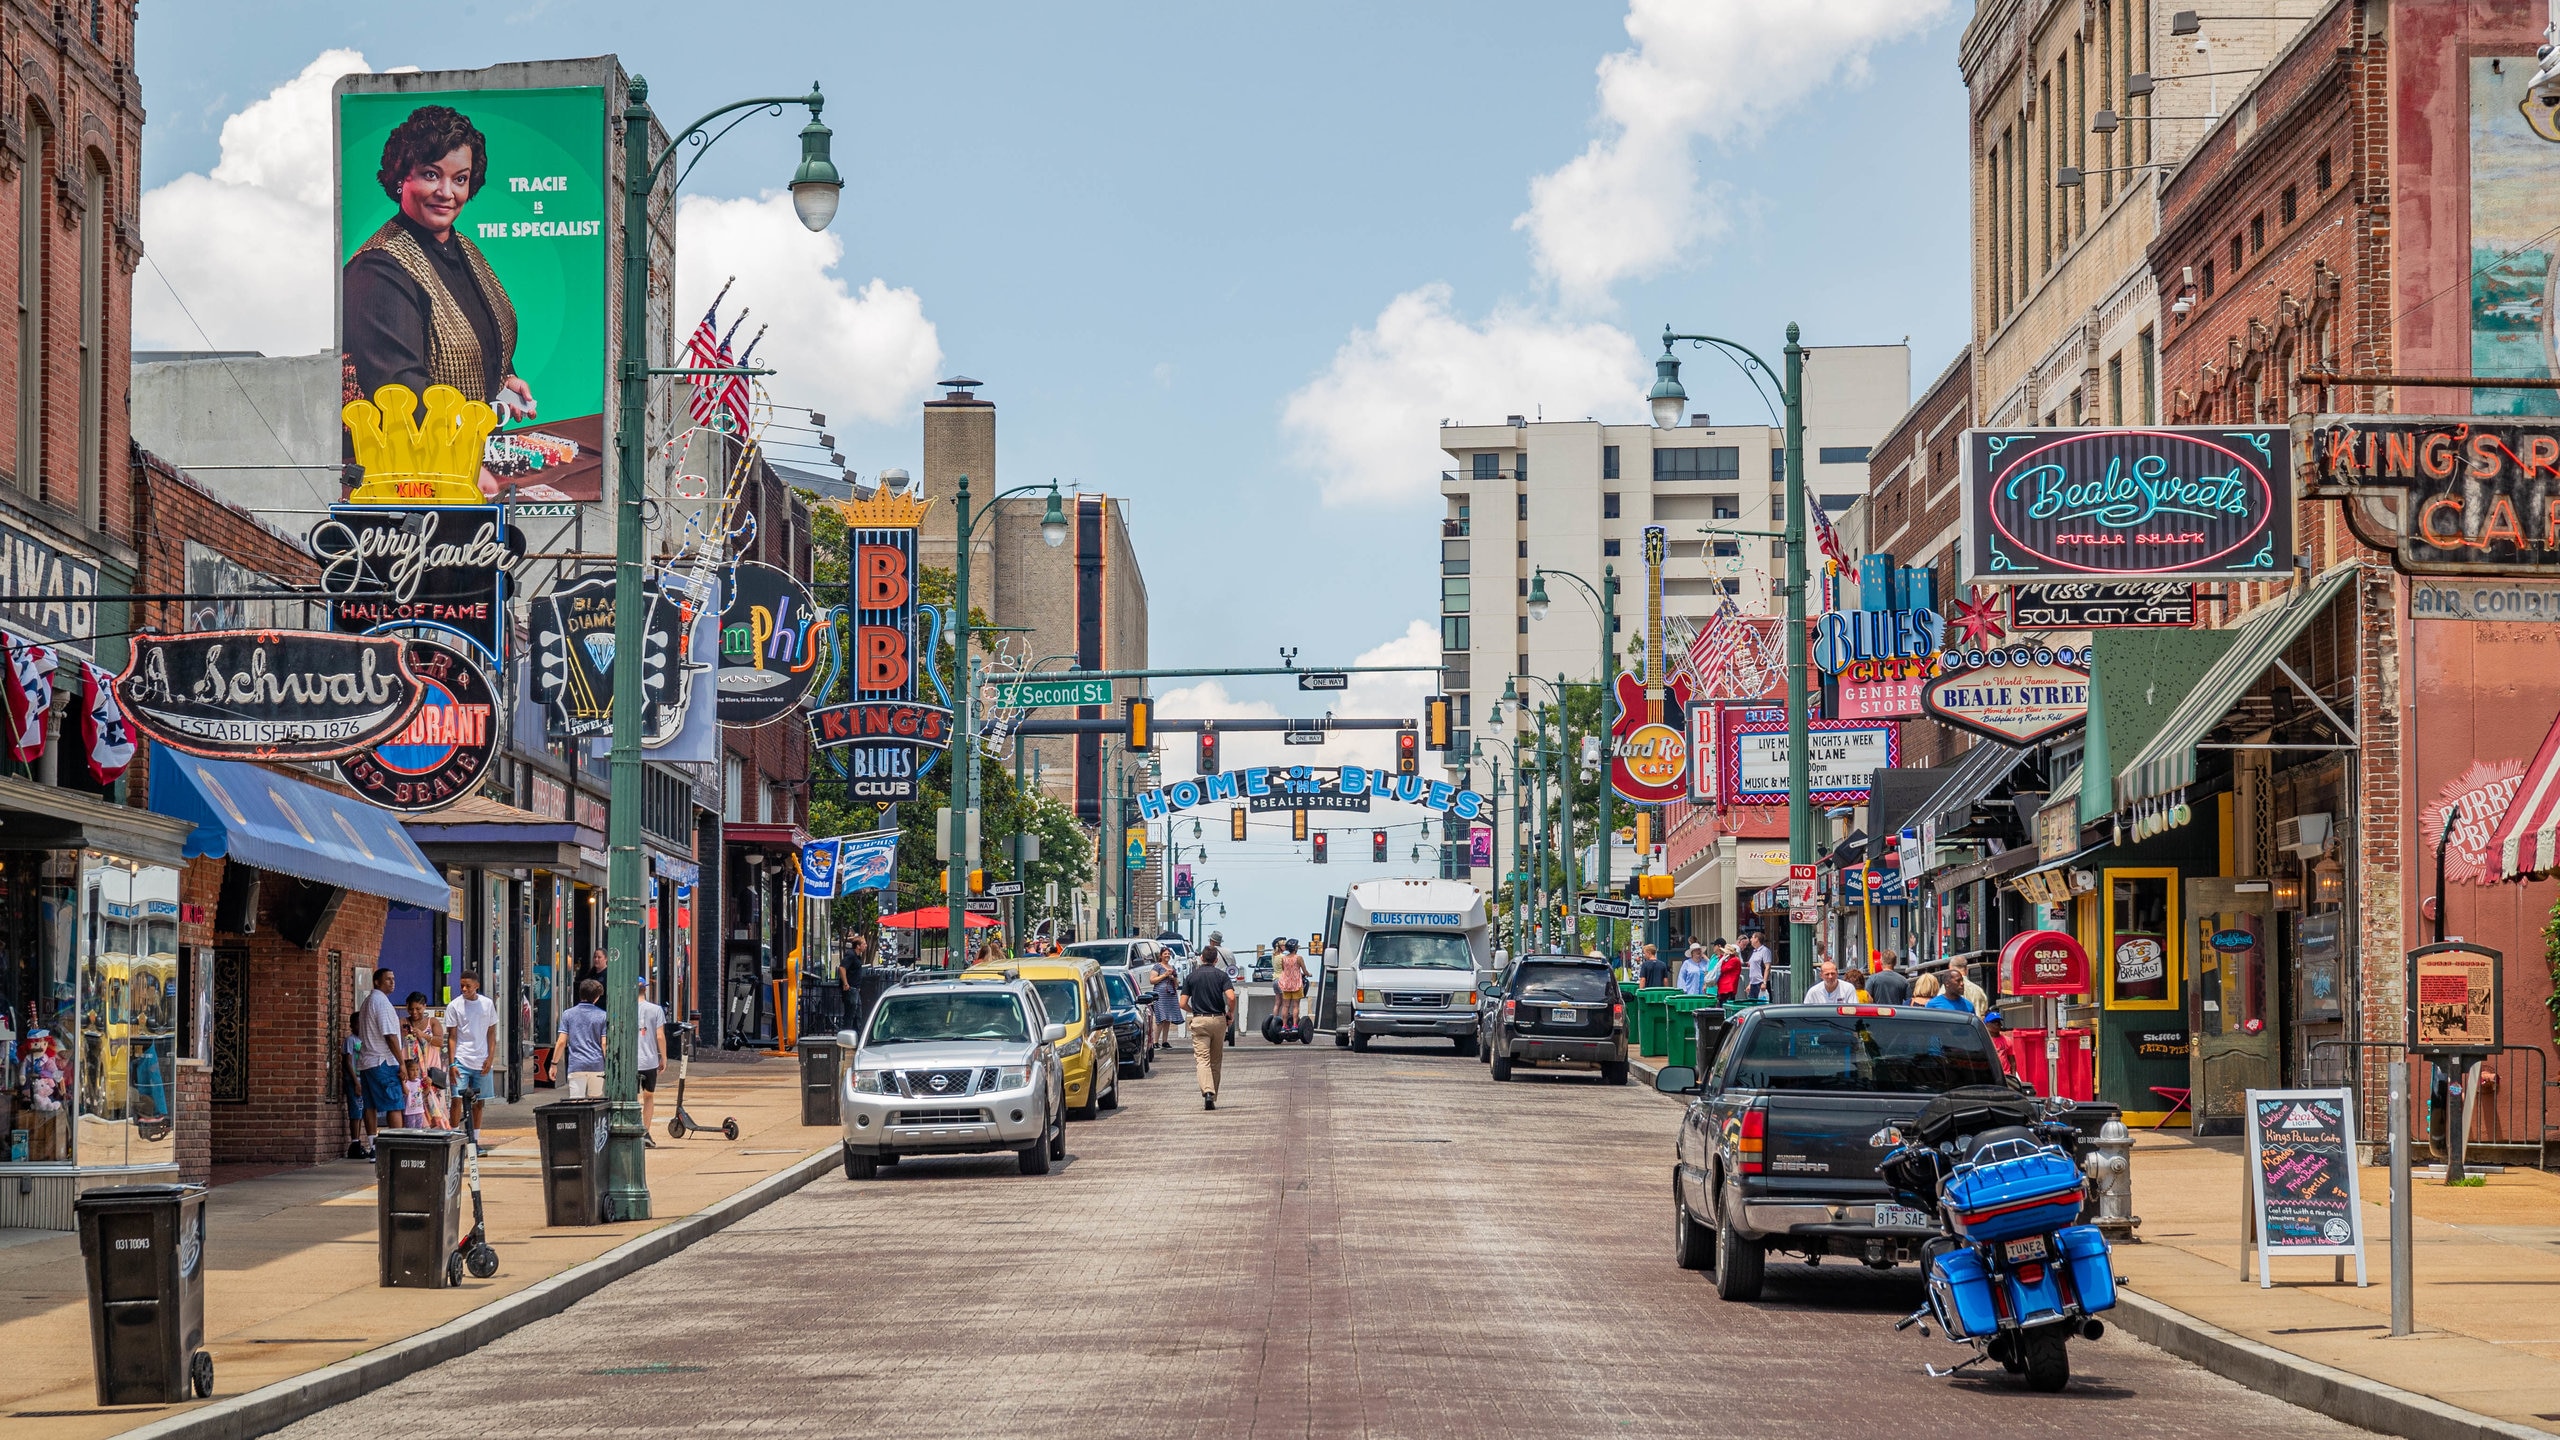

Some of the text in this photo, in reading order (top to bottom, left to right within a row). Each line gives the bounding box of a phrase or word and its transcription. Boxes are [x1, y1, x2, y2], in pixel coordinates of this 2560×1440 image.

[509, 176, 567, 192] TRACIE
[534, 201, 543, 212] IS
[477, 220, 600, 238] THE SPECIALIST
[2327, 423, 2502, 480] KING'S
[2006, 455, 2249, 528] Beale Sweets
[507, 505, 576, 516] AMAR
[2056, 532, 2205, 545] SUGAR SHACK
[311, 511, 518, 604] Jerry Lawler
[573, 597, 616, 611] BLA
[2418, 588, 2462, 613] AIR
[340, 603, 488, 619] HALL OF FAME
[2018, 606, 2191, 625] SOUL CITY CAFE
[567, 611, 616, 632] DIAMO
[718, 595, 831, 672] mphis
[1828, 608, 1934, 675] BLUES
[1945, 649, 2092, 666] WELCOME
[194, 644, 403, 704] Schwab
[1847, 657, 1937, 683] CITY
[1983, 676, 2059, 687] to World Famous
[1023, 685, 1079, 704] Second
[1083, 683, 1106, 701] St.
[1845, 684, 1921, 700] GENERA
[1943, 685, 2090, 707] BEALE STREE
[1860, 699, 1920, 714] STORE
[1745, 709, 1785, 722] BLUES
[1980, 714, 2016, 724] Birthplace
[2025, 713, 2040, 722] Rock
[2047, 713, 2065, 721] Roll
[180, 719, 360, 743] ESTABLISHED 1876
[571, 719, 602, 736] JEWEL
[821, 708, 941, 740] KING'S
[1759, 738, 1775, 749] LIVE
[1813, 735, 1841, 746] NIGHTS
[1844, 735, 1850, 746] A
[1852, 734, 1874, 745] WEEK
[855, 747, 911, 778] BLUES
[1819, 749, 1846, 760] LANE
[1638, 763, 1673, 775] CAFE
[394, 752, 479, 803] BEALE
[1745, 777, 1769, 788] MUSIC
[1771, 777, 1778, 787] &
[1808, 775, 1823, 786] HAT
[1826, 774, 1849, 786] CAN'T
[1852, 774, 1861, 785] BE
[855, 782, 911, 796] CLUB
[1137, 766, 1483, 821] HOME OF THE BLUES
[1260, 797, 1361, 809] BEALE STREET
[848, 838, 895, 851] MEMPHIS
[1794, 867, 1811, 878] NO
[1867, 876, 1881, 884] STOP
[1594, 903, 1608, 911] ONE
[1372, 912, 1459, 925] BLUES CITY TOURS
[2034, 950, 2068, 959] GRAB
[2035, 963, 2068, 972] BUDS
[2120, 962, 2159, 980] BREAKFAST
[2140, 1044, 2169, 1055] FRIED
[2287, 1111, 2316, 1121] Coors
[2266, 1129, 2290, 1145] Kings
[2290, 1130, 2319, 1142] Palace
[1772, 1162, 1829, 1172] SIERRA
[2262, 1147, 2295, 1171] Monday
[469, 1156, 477, 1181] BIRD
[2301, 1172, 2330, 1199] Special
[1877, 1211, 1925, 1226] 815 SAE
[2293, 1207, 2309, 1215] with
